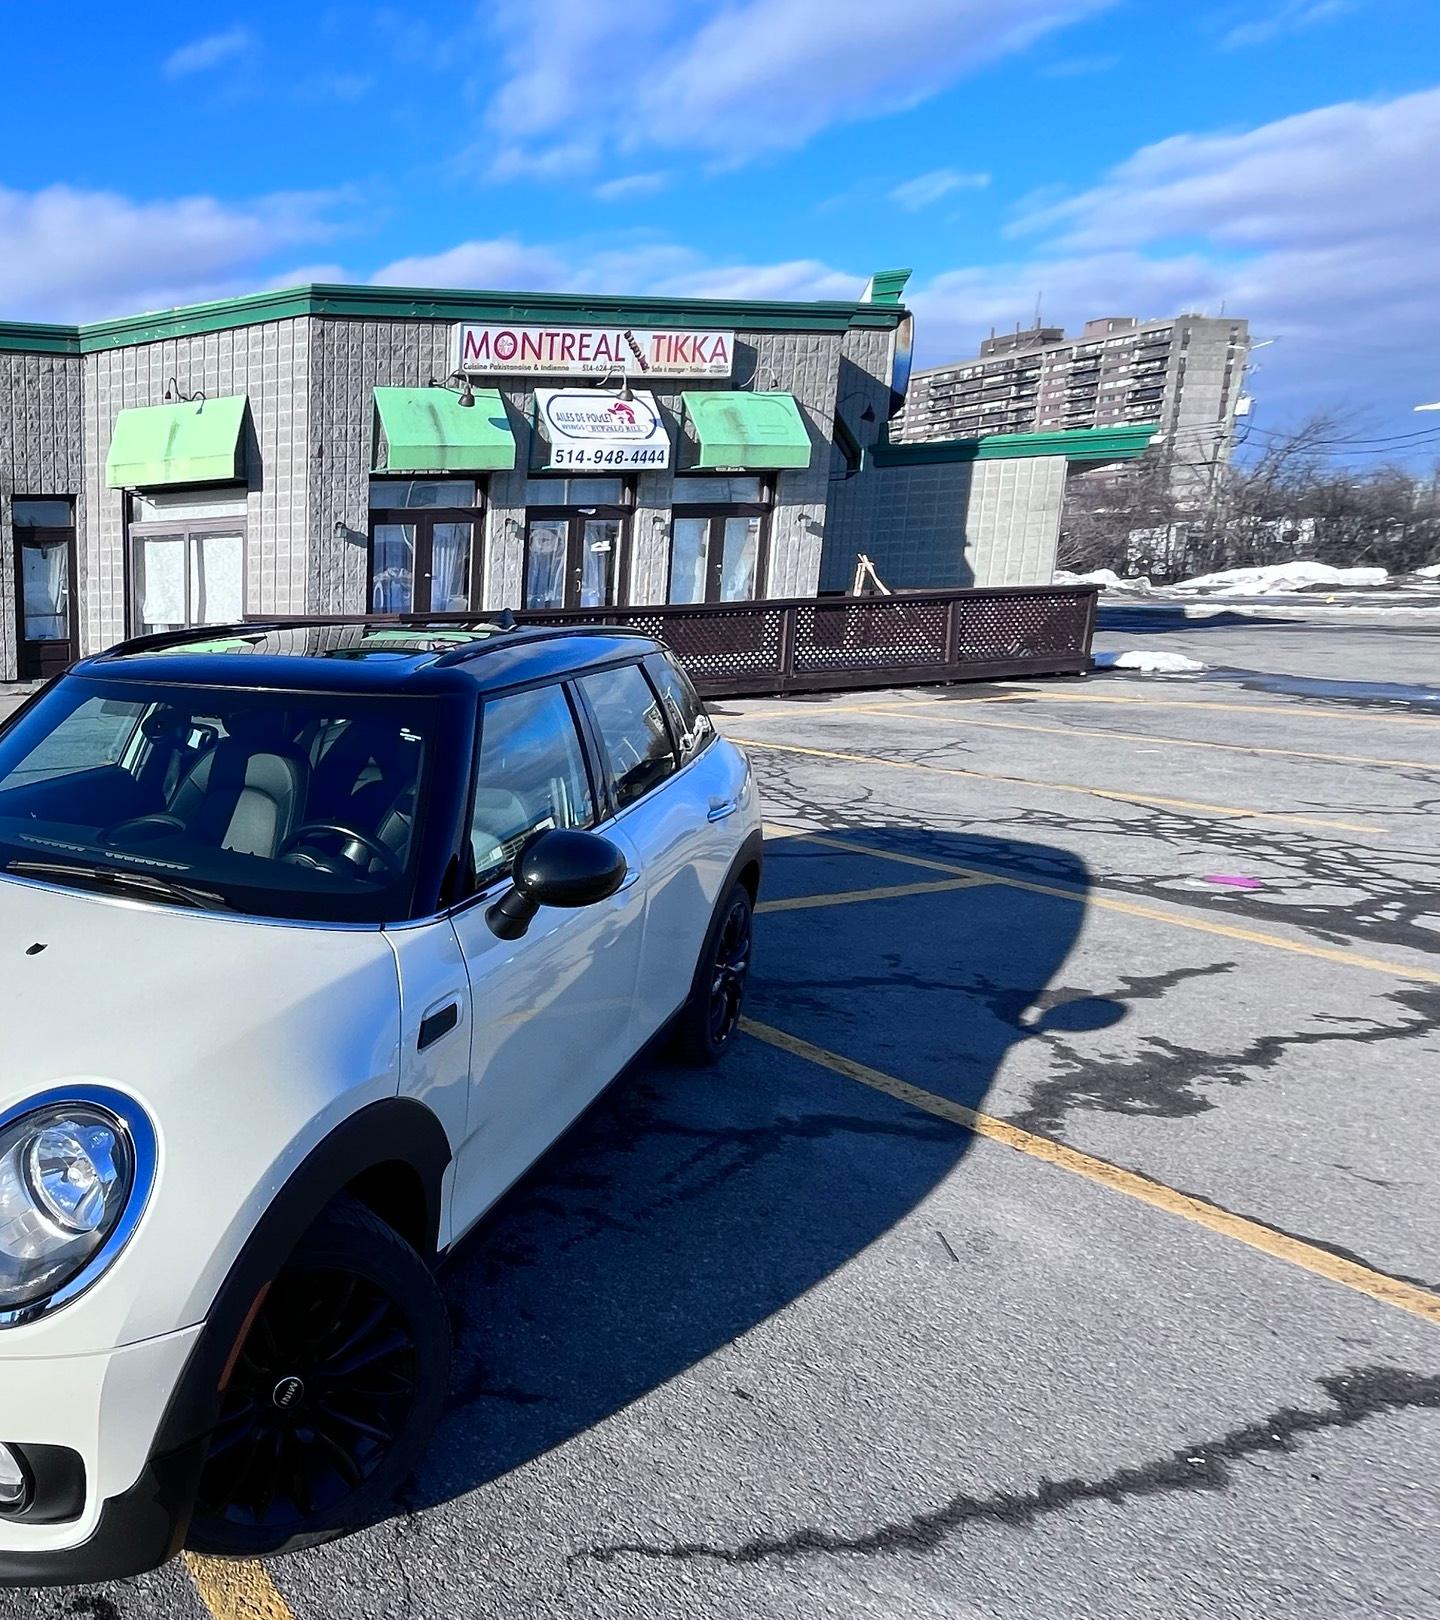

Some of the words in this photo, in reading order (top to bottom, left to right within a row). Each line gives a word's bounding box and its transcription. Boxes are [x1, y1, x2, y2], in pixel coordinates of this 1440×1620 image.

[463, 330, 626, 362] MONTREAL
[651, 334, 729, 363] TIKKA
[463, 362, 488, 370] Cuisine
[489, 363, 531, 371] Pakistanaise
[556, 412, 575, 423] AILES
[575, 412, 586, 423] DE
[587, 413, 613, 423] POULET
[555, 449, 665, 465] 514-948-4444
[280, 1381, 298, 1405] MINI
